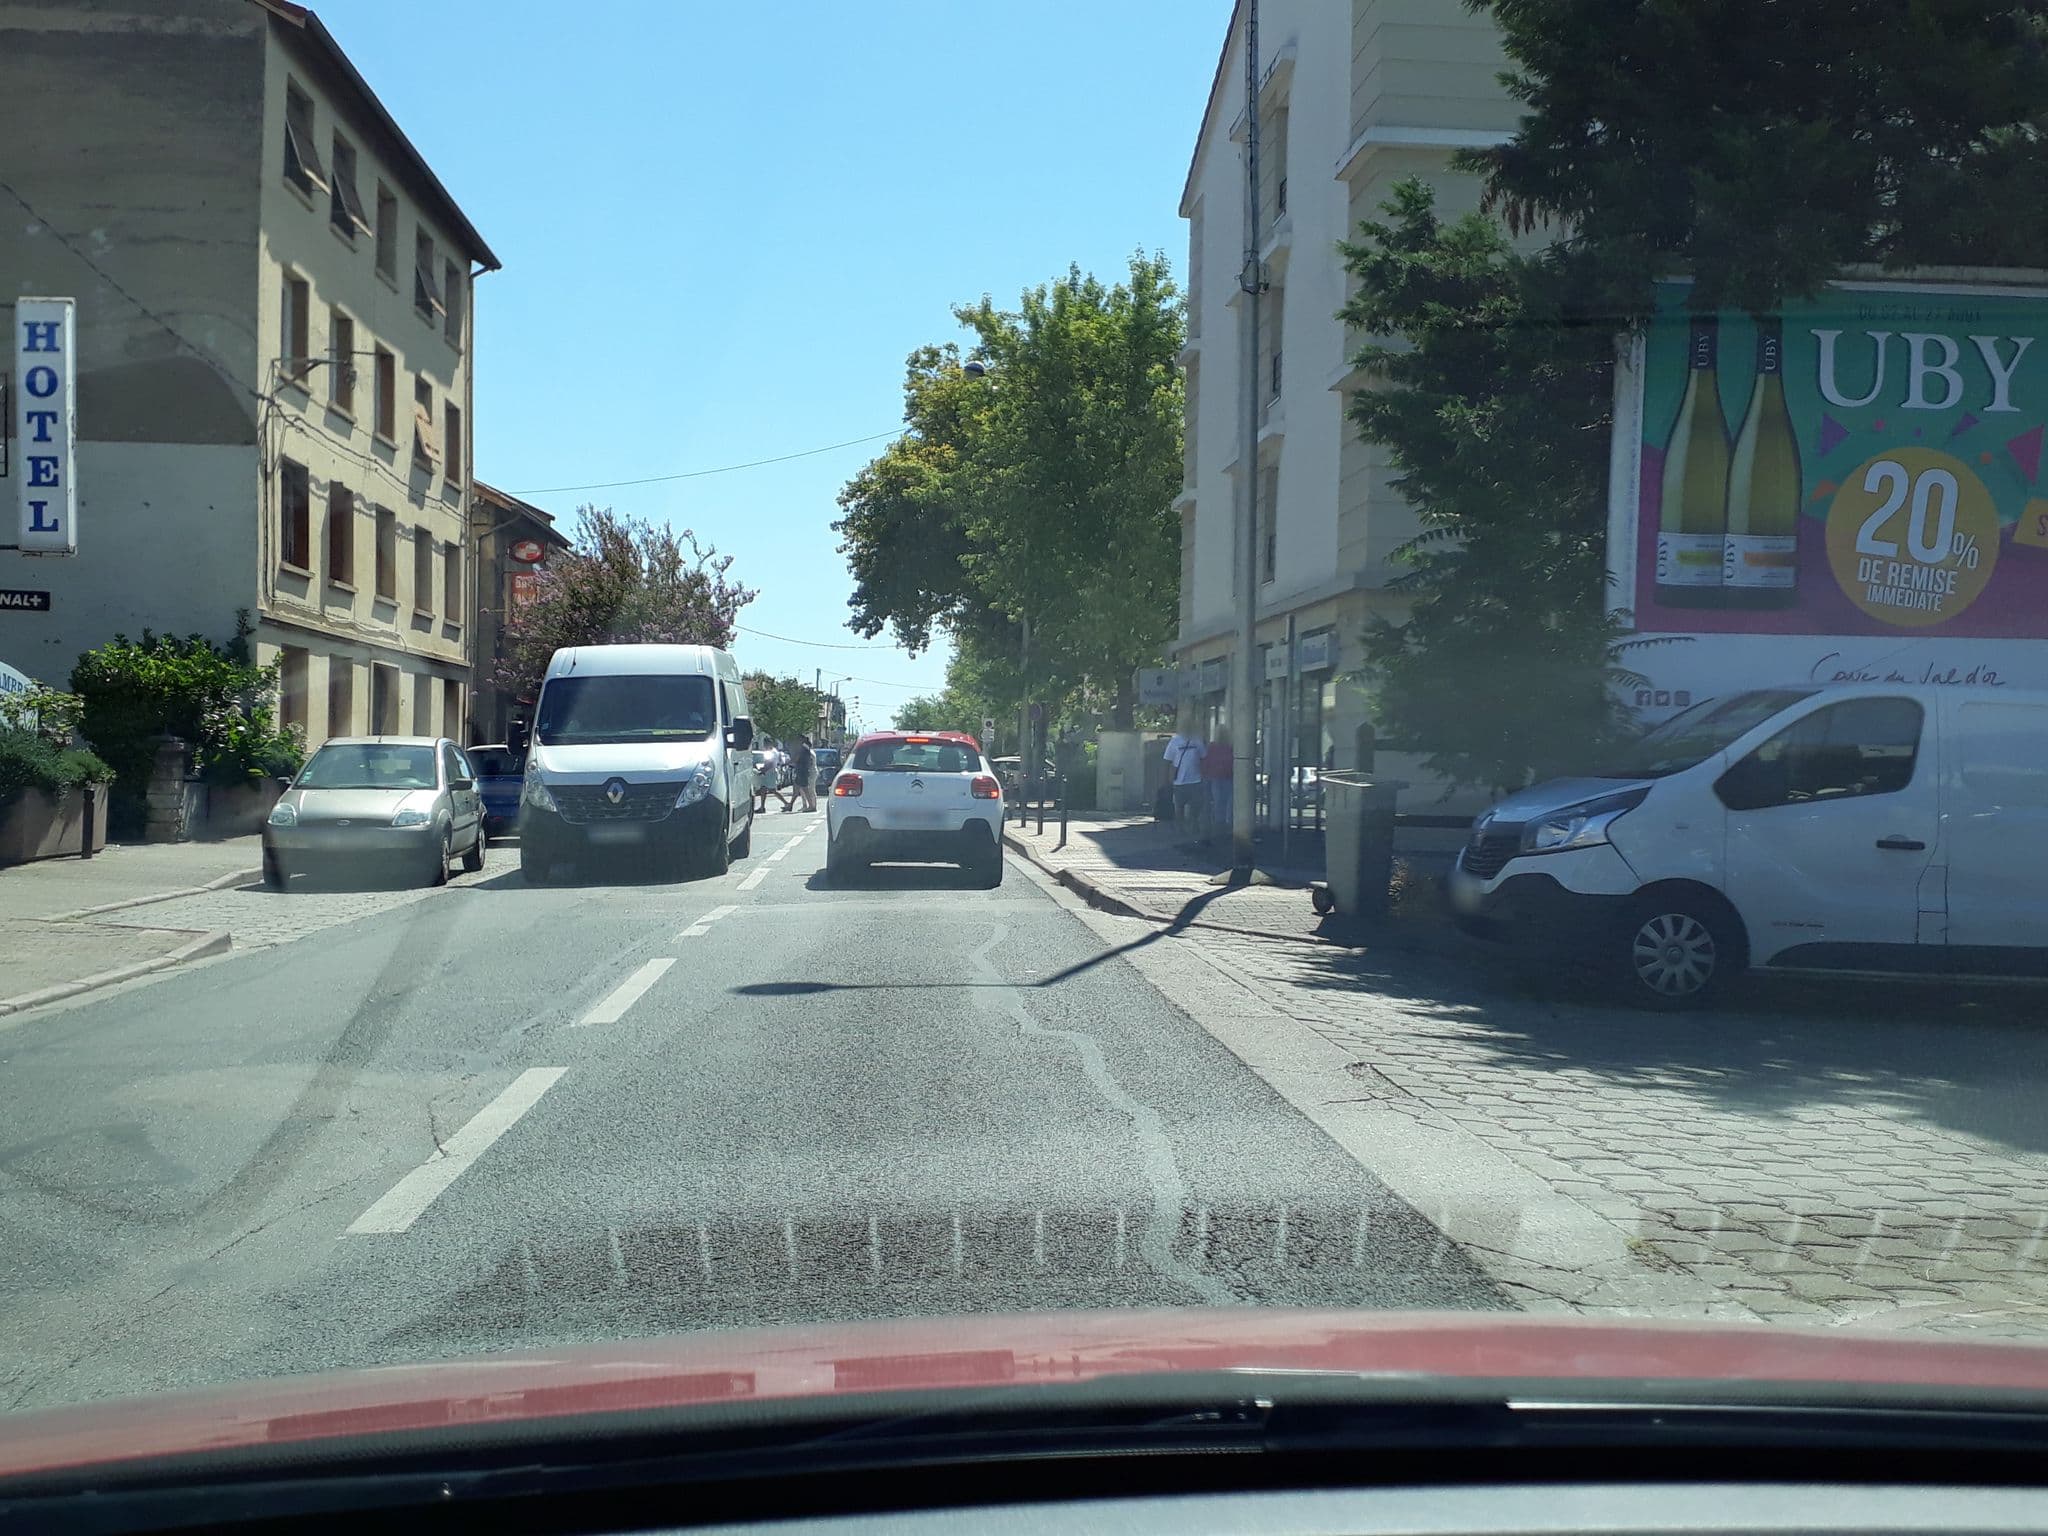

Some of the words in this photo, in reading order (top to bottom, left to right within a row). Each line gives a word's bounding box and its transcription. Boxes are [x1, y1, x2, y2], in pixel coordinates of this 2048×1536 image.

[1697, 333, 1709, 367] UBY
[1765, 336, 1777, 371] UBY
[1810, 329, 2035, 413] UBY
[23, 321, 61, 532] HOTEL
[1856, 459, 1979, 569] 20%
[1857, 558, 1885, 584] DE
[1887, 561, 1958, 595] REMISE
[1867, 584, 1944, 612] IMMEDIATE
[1919, 660, 1966, 685] Val
